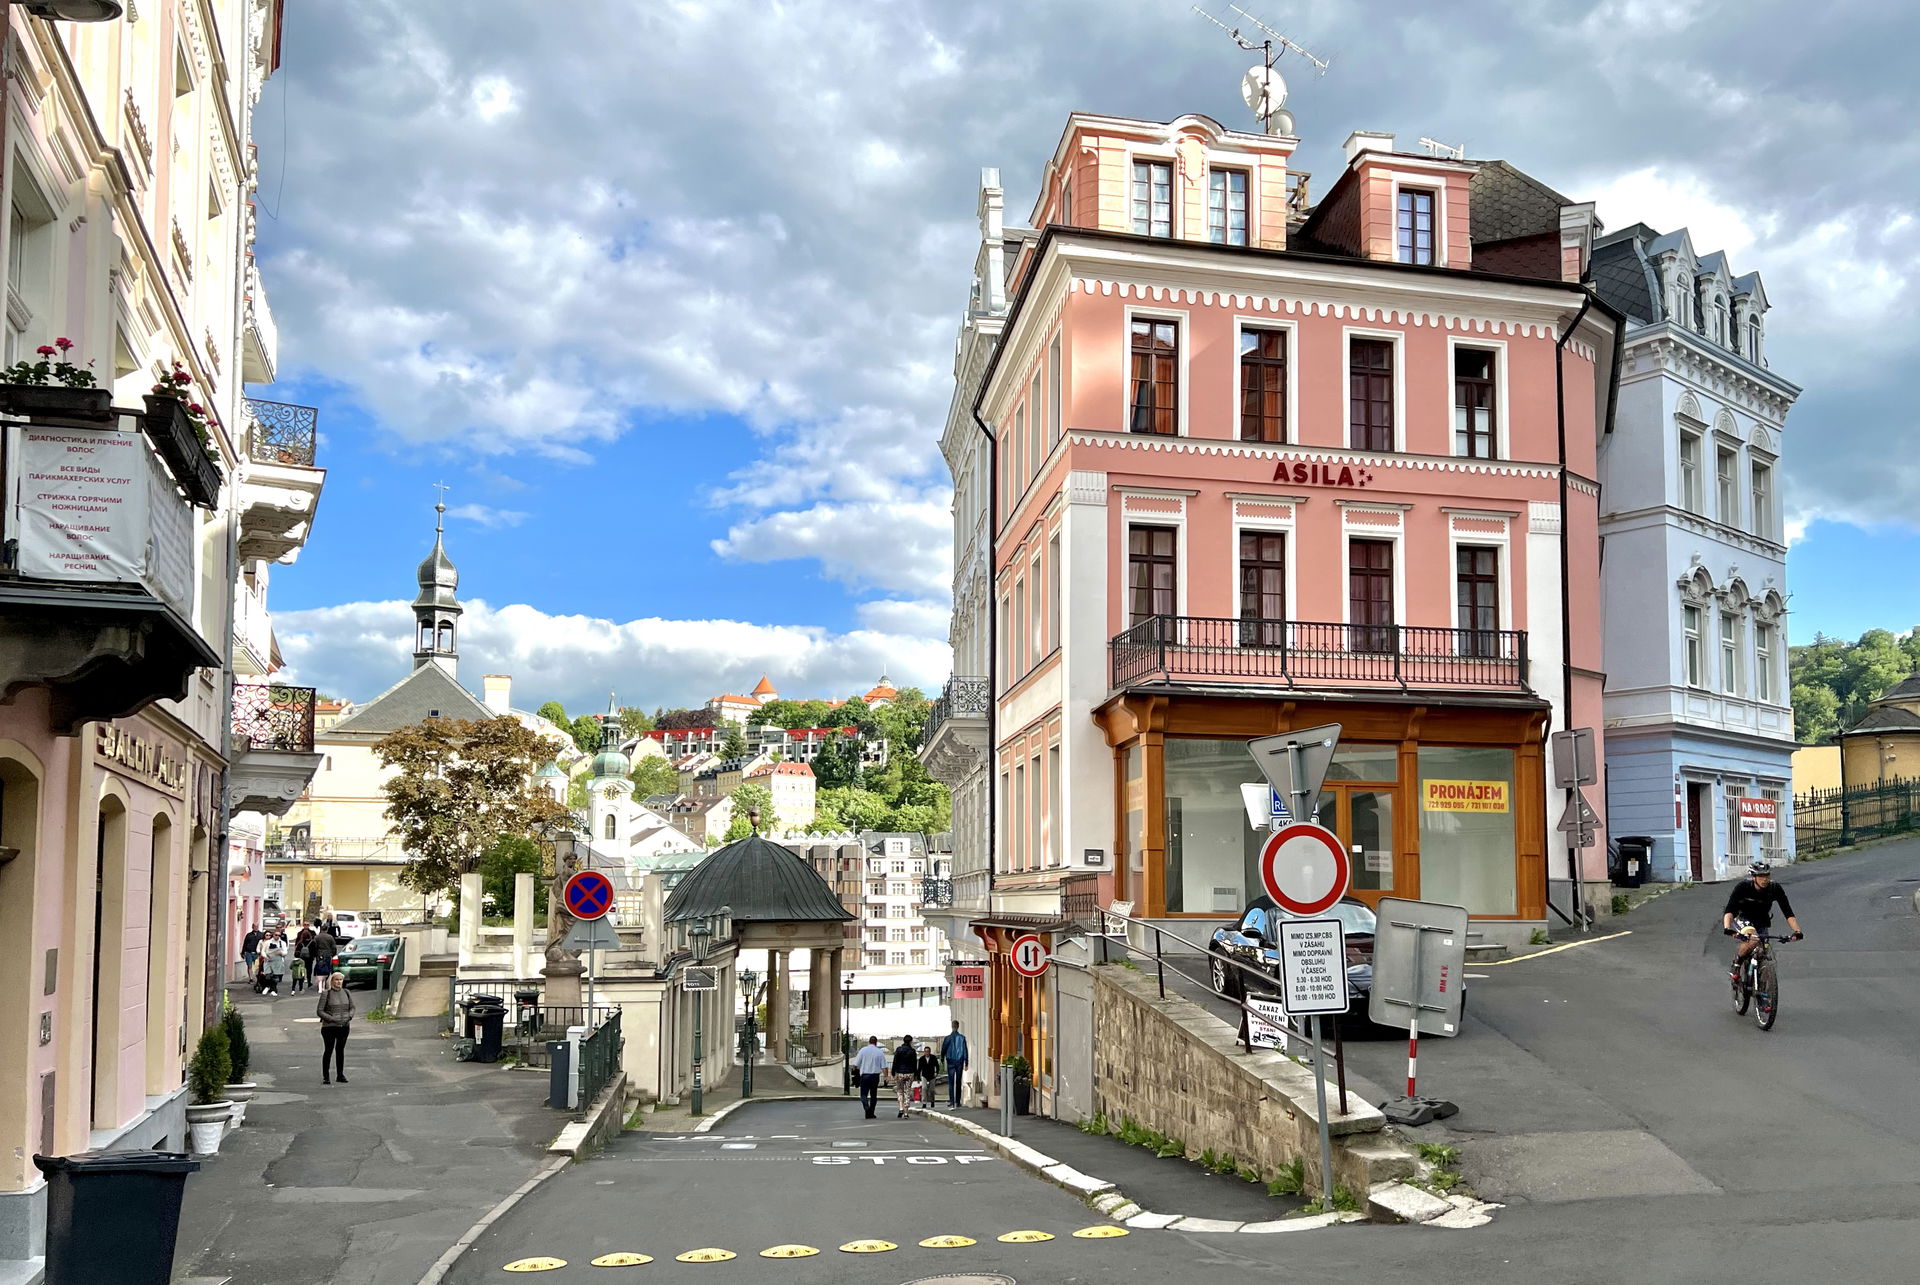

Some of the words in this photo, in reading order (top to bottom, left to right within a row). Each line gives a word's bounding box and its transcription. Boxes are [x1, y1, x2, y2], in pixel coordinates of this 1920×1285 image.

[28, 434, 88, 444] ДИАГНОСТИКА
[96, 438, 133, 447] ЛЕЧЕНИЕ
[66, 446, 95, 454] ВОЛОС
[76, 466, 101, 474] ВИДЫ
[1273, 461, 1354, 486] ASILA
[28, 473, 105, 484] ПАРИКМАХЕРСКИХ
[106, 477, 131, 485] УСЛУГ
[37, 493, 76, 502] СТРИЖКА
[78, 495, 122, 504] ГОРЯЧИМИ
[52, 504, 108, 513] НОЖНИЦАМИ
[49, 523, 111, 533] НАРАЩИВАНИЕ
[66, 533, 94, 541] ВОЛОС
[49, 552, 112, 561] НАРАЩИВАНИЕ
[64, 563, 97, 571] РЕСНИЦ
[1430, 782, 1502, 800] PRONÁJEM
[1304, 940, 1325, 948] ZÁSAHU
[1307, 948, 1333, 957] DOPRAVNÍ
[1305, 966, 1327, 974] ČASECH
[956, 974, 983, 984] HOTEL
[812, 1155, 994, 1165] STOP
